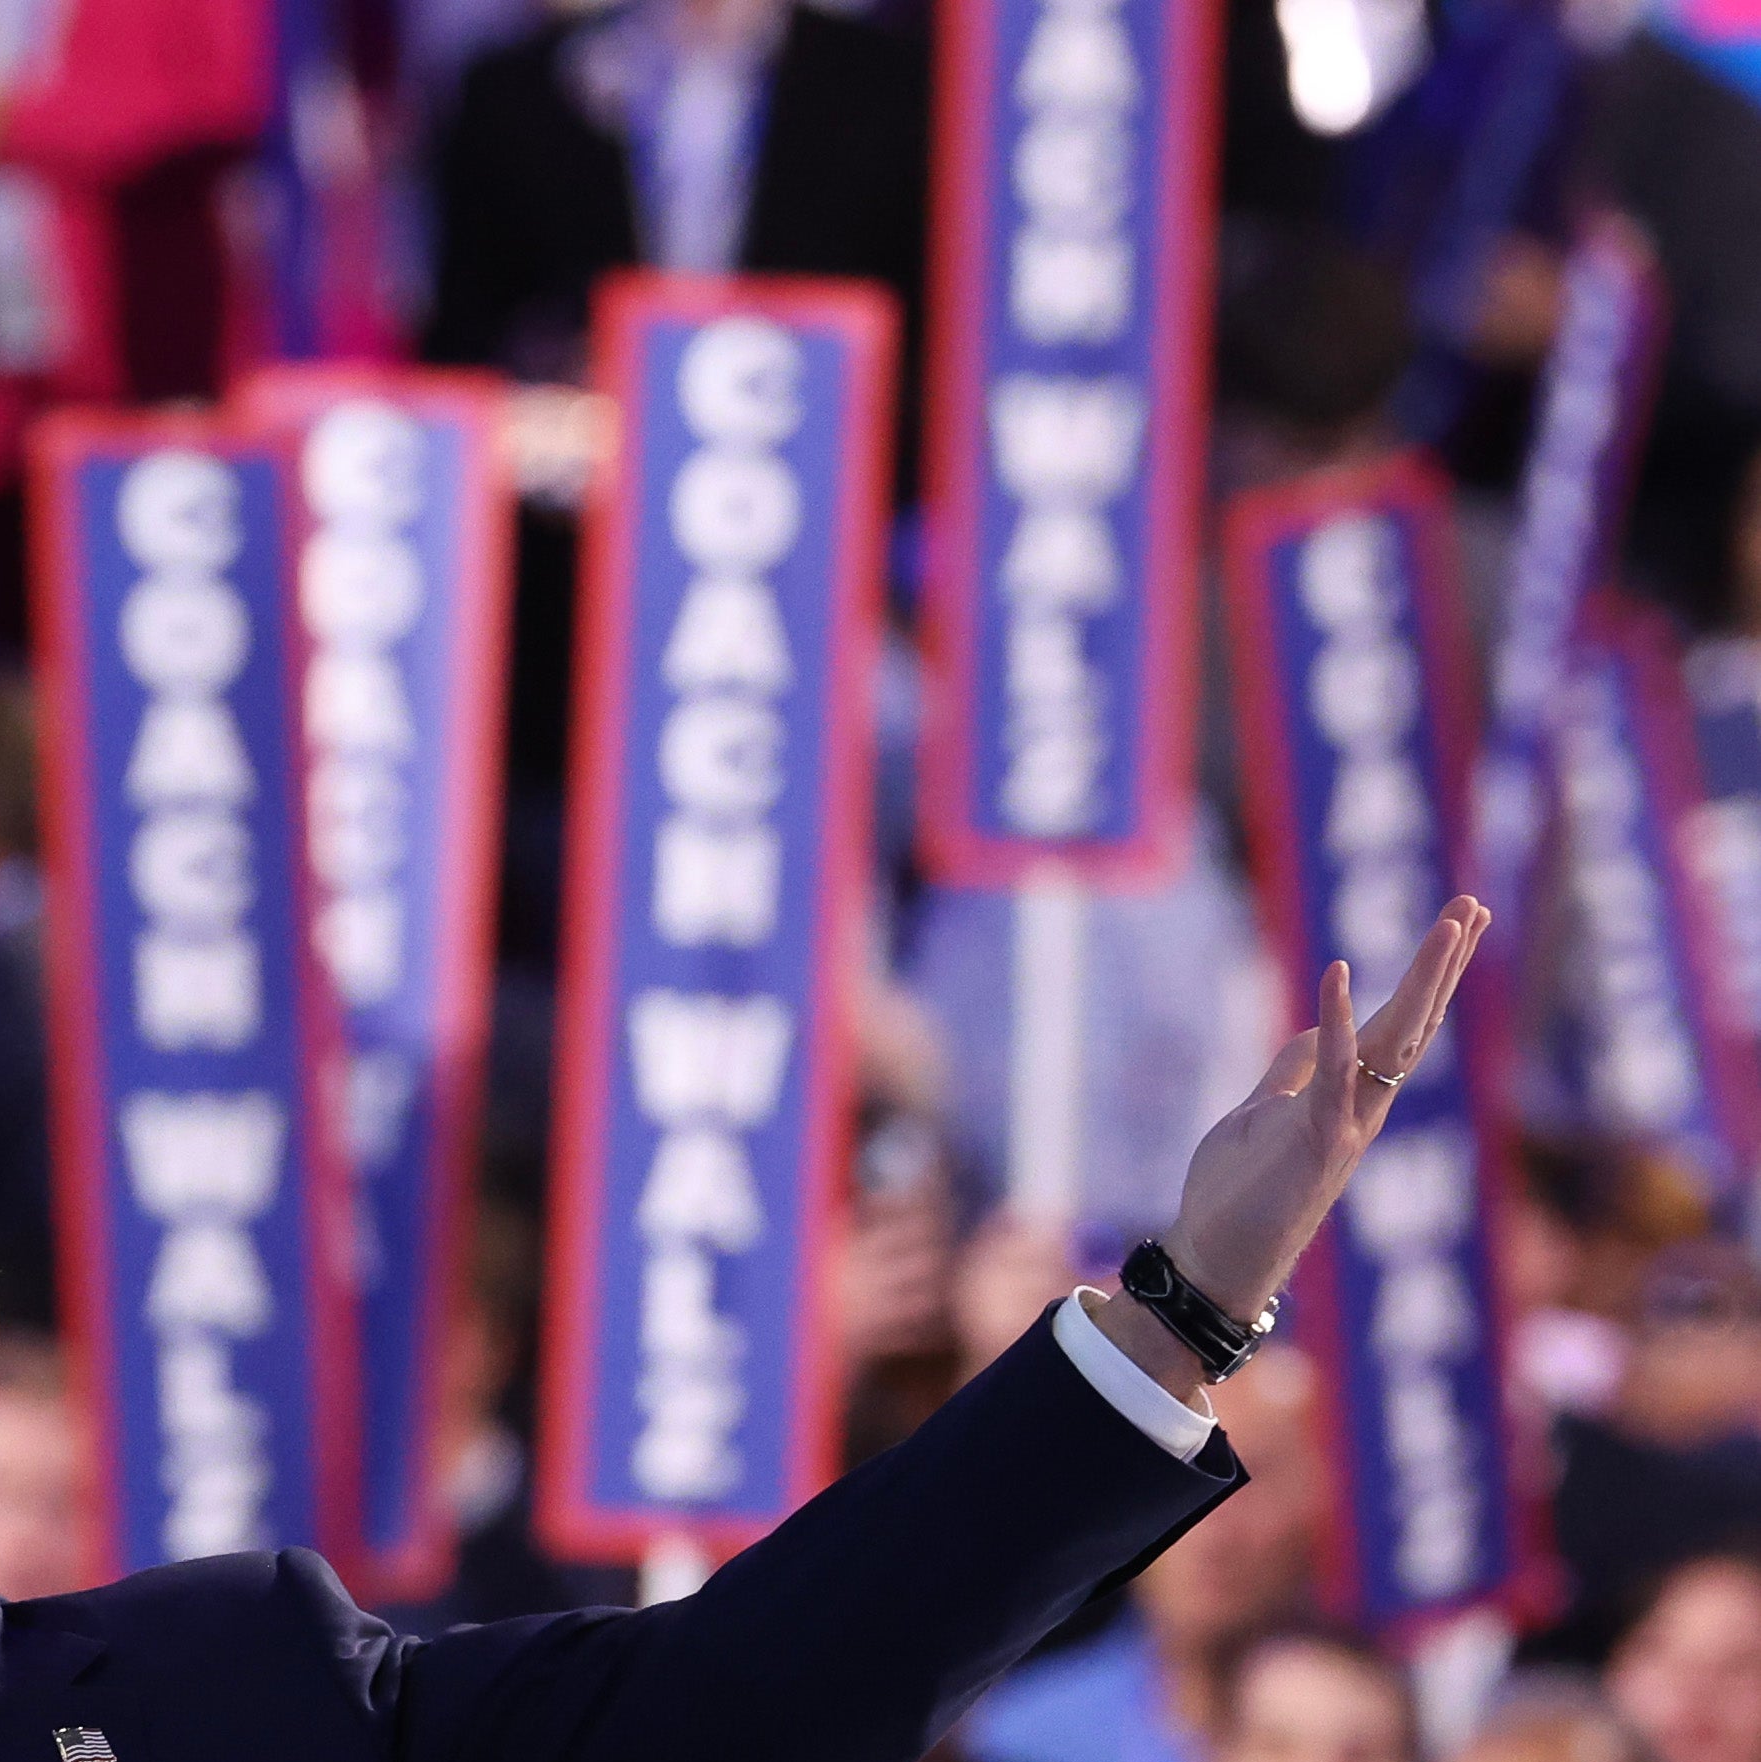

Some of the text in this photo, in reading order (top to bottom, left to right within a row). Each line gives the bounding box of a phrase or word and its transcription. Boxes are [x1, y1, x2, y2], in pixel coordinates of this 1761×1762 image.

[117, 446, 291, 1562] COACH WALZ
[625, 312, 805, 1508] COACH WALZ
[983, 368, 1151, 840] WALZ
